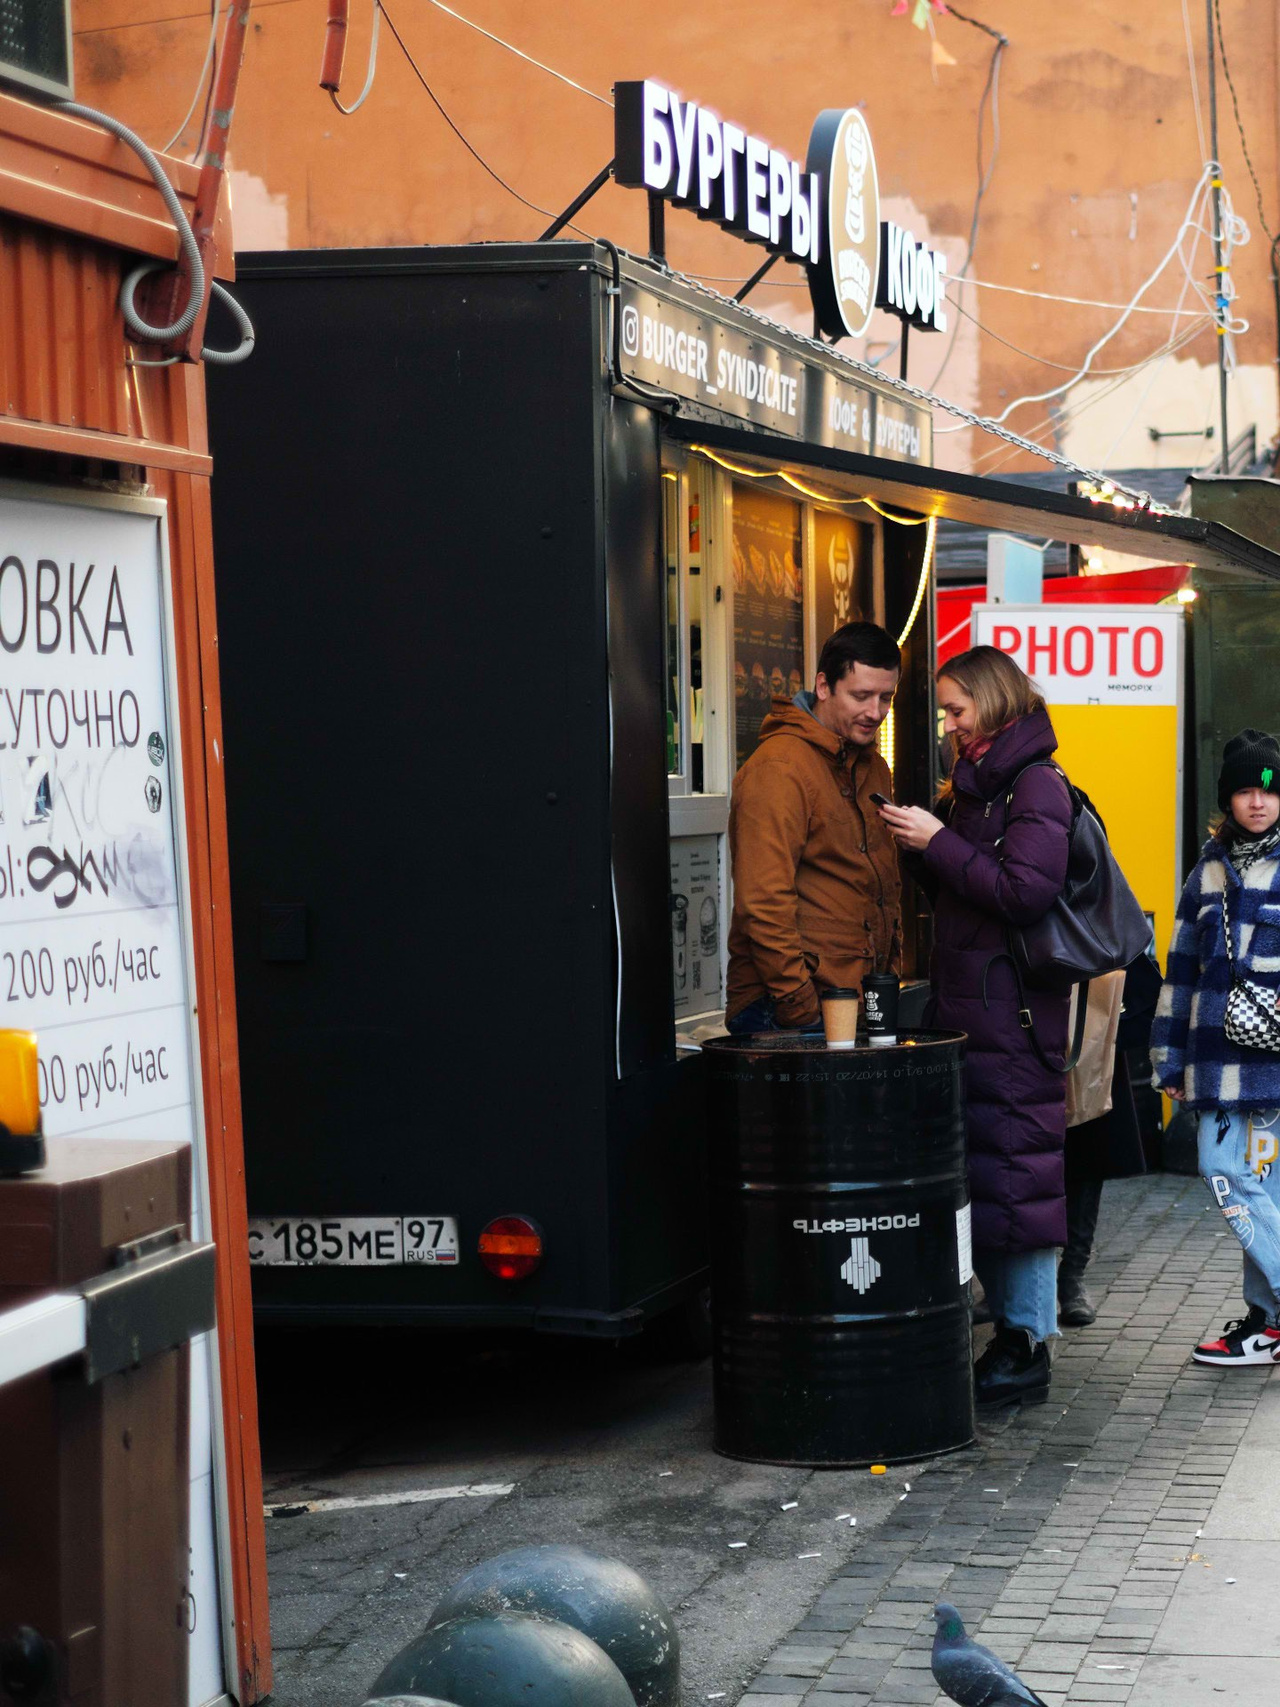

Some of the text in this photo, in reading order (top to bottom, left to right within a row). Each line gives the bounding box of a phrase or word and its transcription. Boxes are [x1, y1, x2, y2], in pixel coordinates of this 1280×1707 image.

[644, 79, 819, 265] БУРГЕРЫ
[887, 220, 948, 333] КОФЕ
[642, 315, 797, 416] BURGER_SYNDICATE
[875, 414, 921, 459] БУРГЕРЫ
[992, 625, 1164, 678] PHOTO
[3, 938, 161, 1006] 200 руб./час
[75, 1041, 169, 1112] руб./час
[407, 1220, 445, 1248] 97
[793, 1213, 920, 1234] РОСНЕФТЬ
[407, 1251, 434, 1261] RUS
